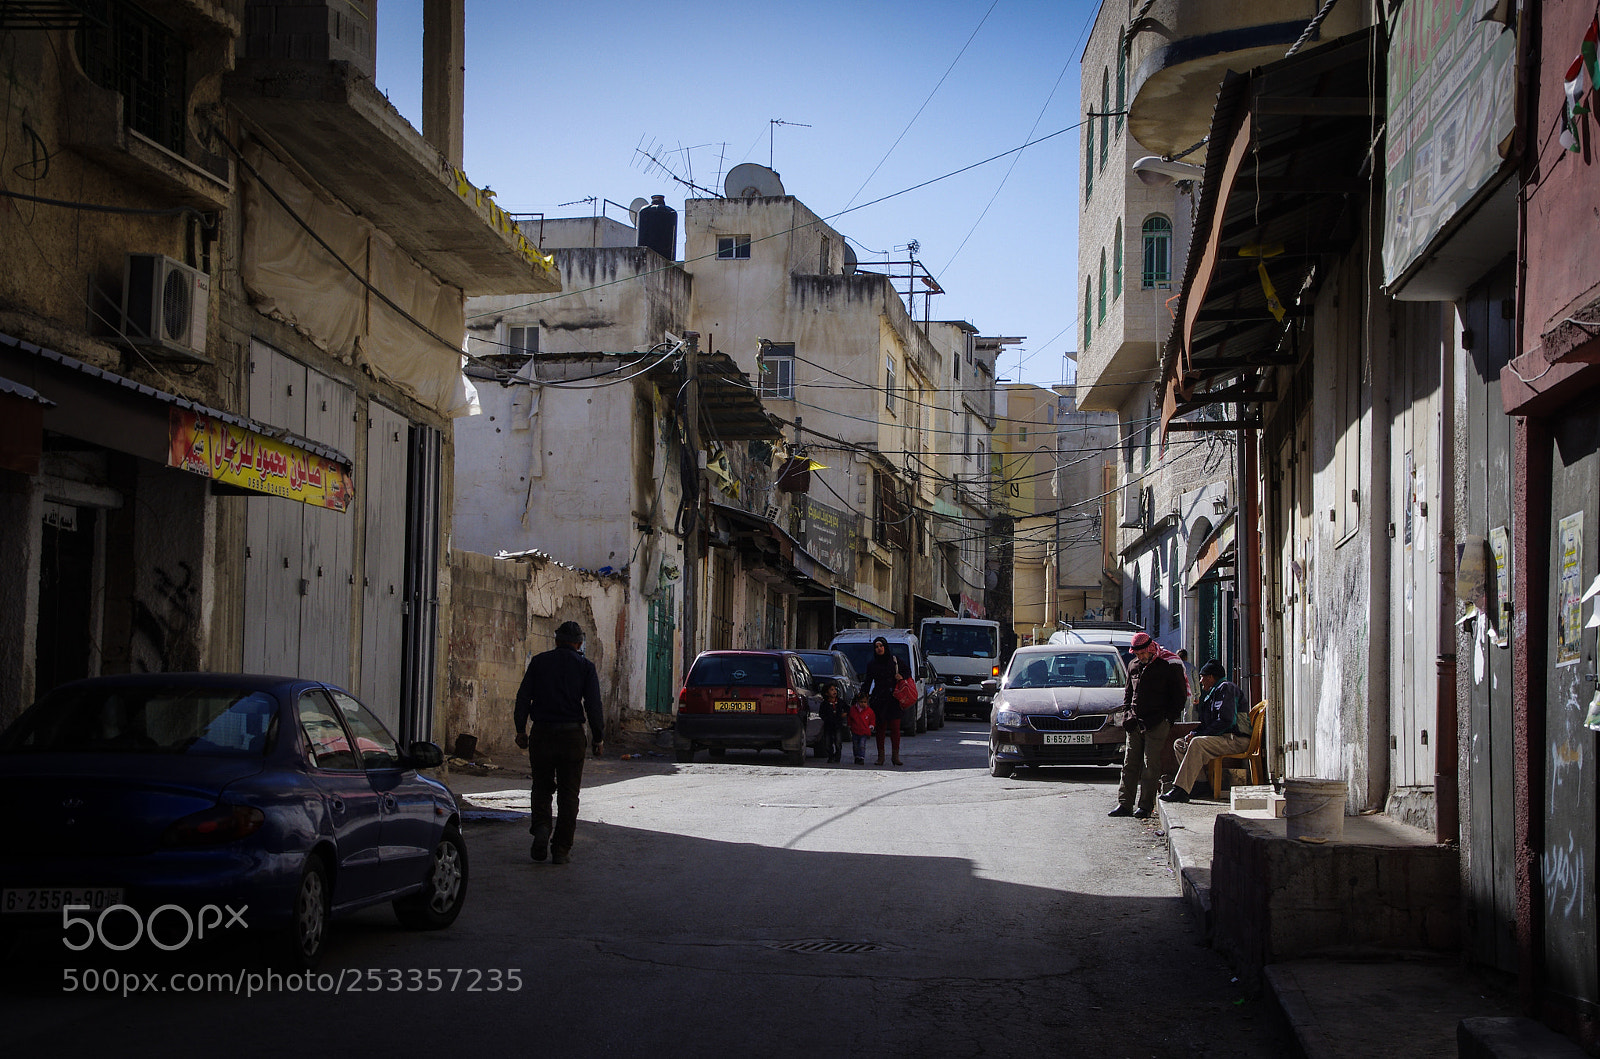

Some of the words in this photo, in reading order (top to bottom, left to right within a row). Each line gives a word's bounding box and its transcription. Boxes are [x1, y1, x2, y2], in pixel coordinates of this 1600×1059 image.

[214, 422, 254, 475] للرجال
[255, 443, 287, 481] محمود
[290, 452, 322, 491] صالون
